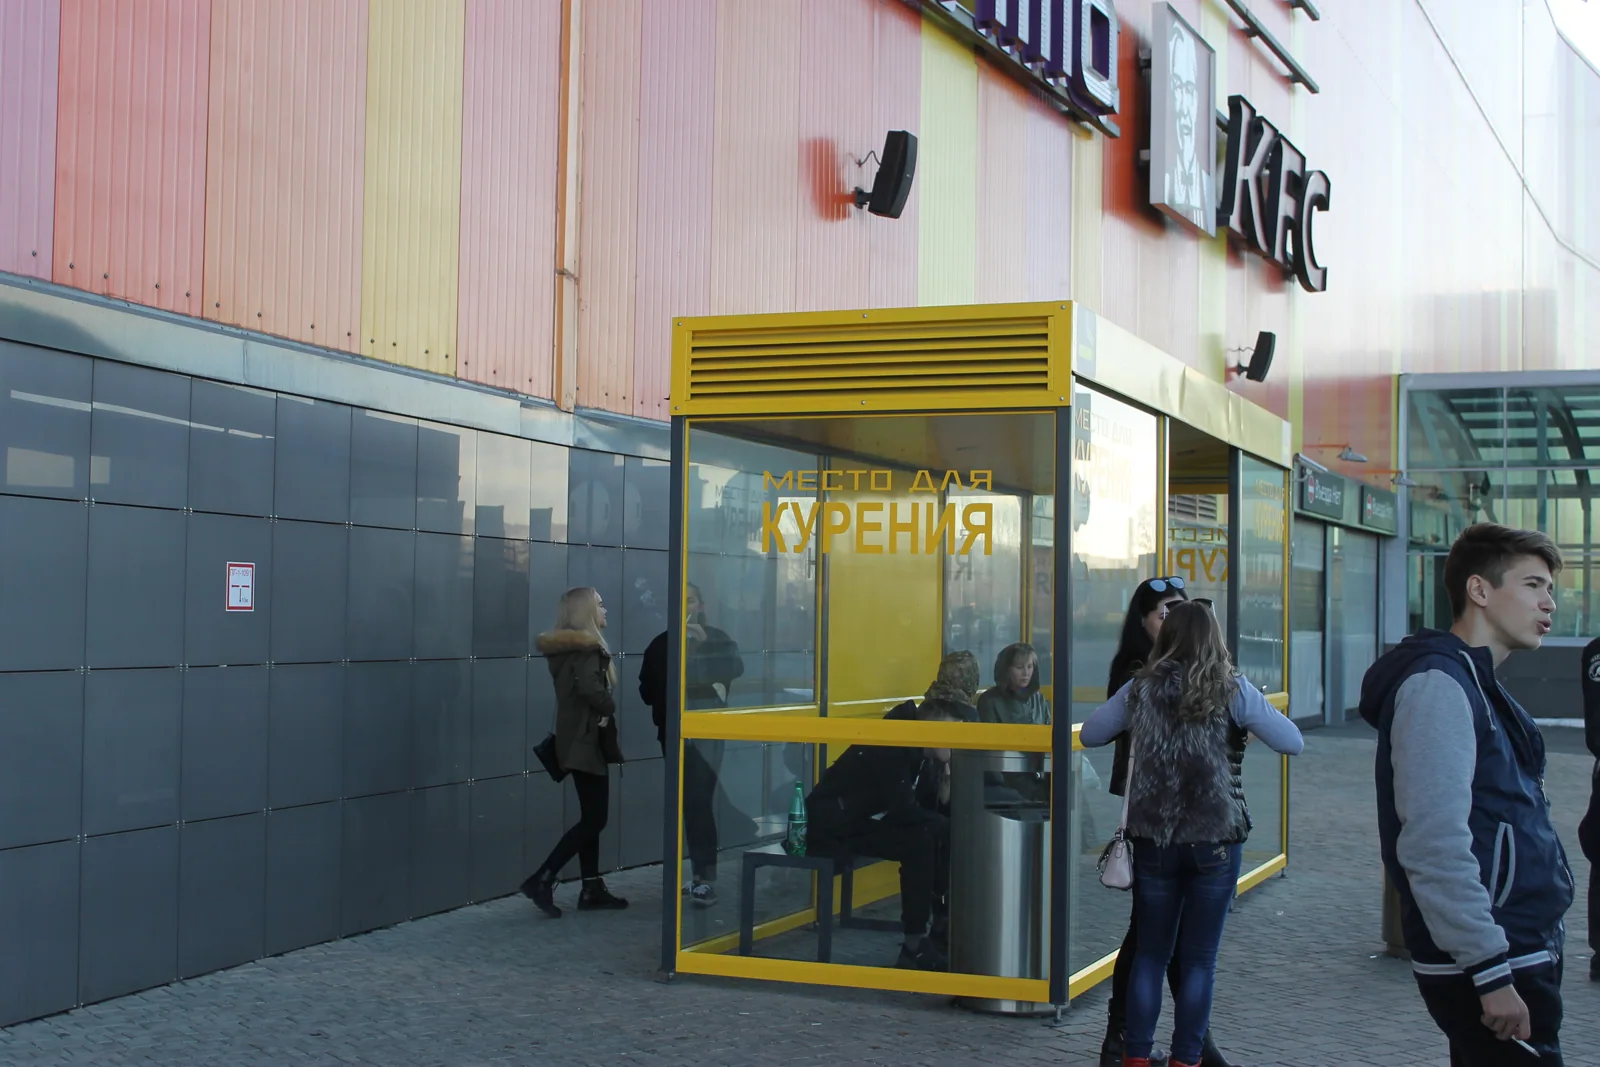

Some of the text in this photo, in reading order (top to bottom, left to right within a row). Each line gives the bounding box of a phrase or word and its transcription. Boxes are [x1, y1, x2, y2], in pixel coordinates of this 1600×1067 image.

[1226, 94, 1331, 293] KFC
[763, 470, 993, 494] МЕСТО ДЛЯ
[761, 501, 993, 556] КУРЕНИЯ
